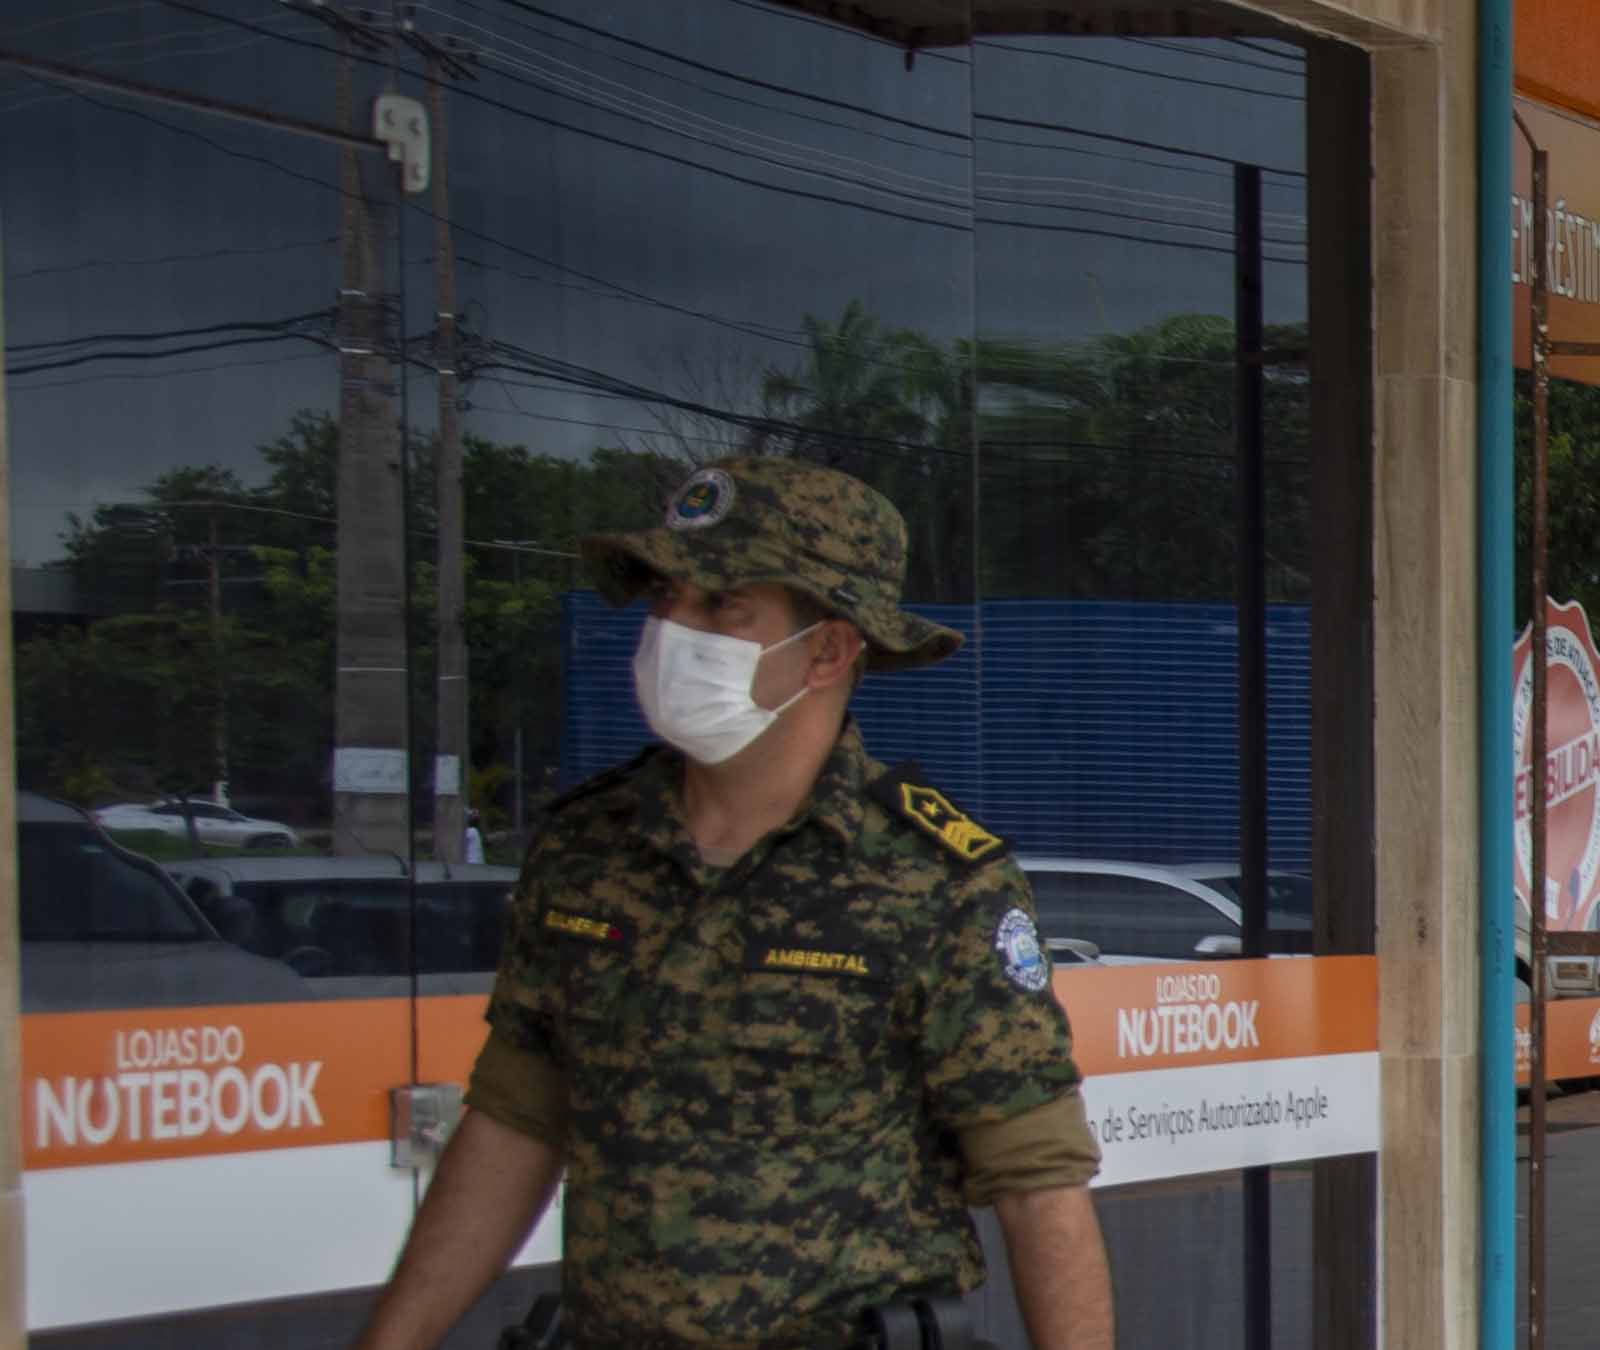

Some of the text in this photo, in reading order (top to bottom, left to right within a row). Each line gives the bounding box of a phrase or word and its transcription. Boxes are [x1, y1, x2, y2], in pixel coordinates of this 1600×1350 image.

[765, 948, 869, 977] AMBIENTAL
[1156, 973, 1220, 1002] LOJAS DO
[116, 1025, 244, 1069] LOJAS DO
[1117, 1000, 1260, 1058] NOTEBOOK
[35, 1060, 325, 1149] NOTEBOOK
[1102, 1103, 1123, 1145] de
[1128, 1104, 1194, 1146] Serviços
[1200, 1090, 1281, 1133] Autorizado
[1285, 1085, 1329, 1130] Apple
